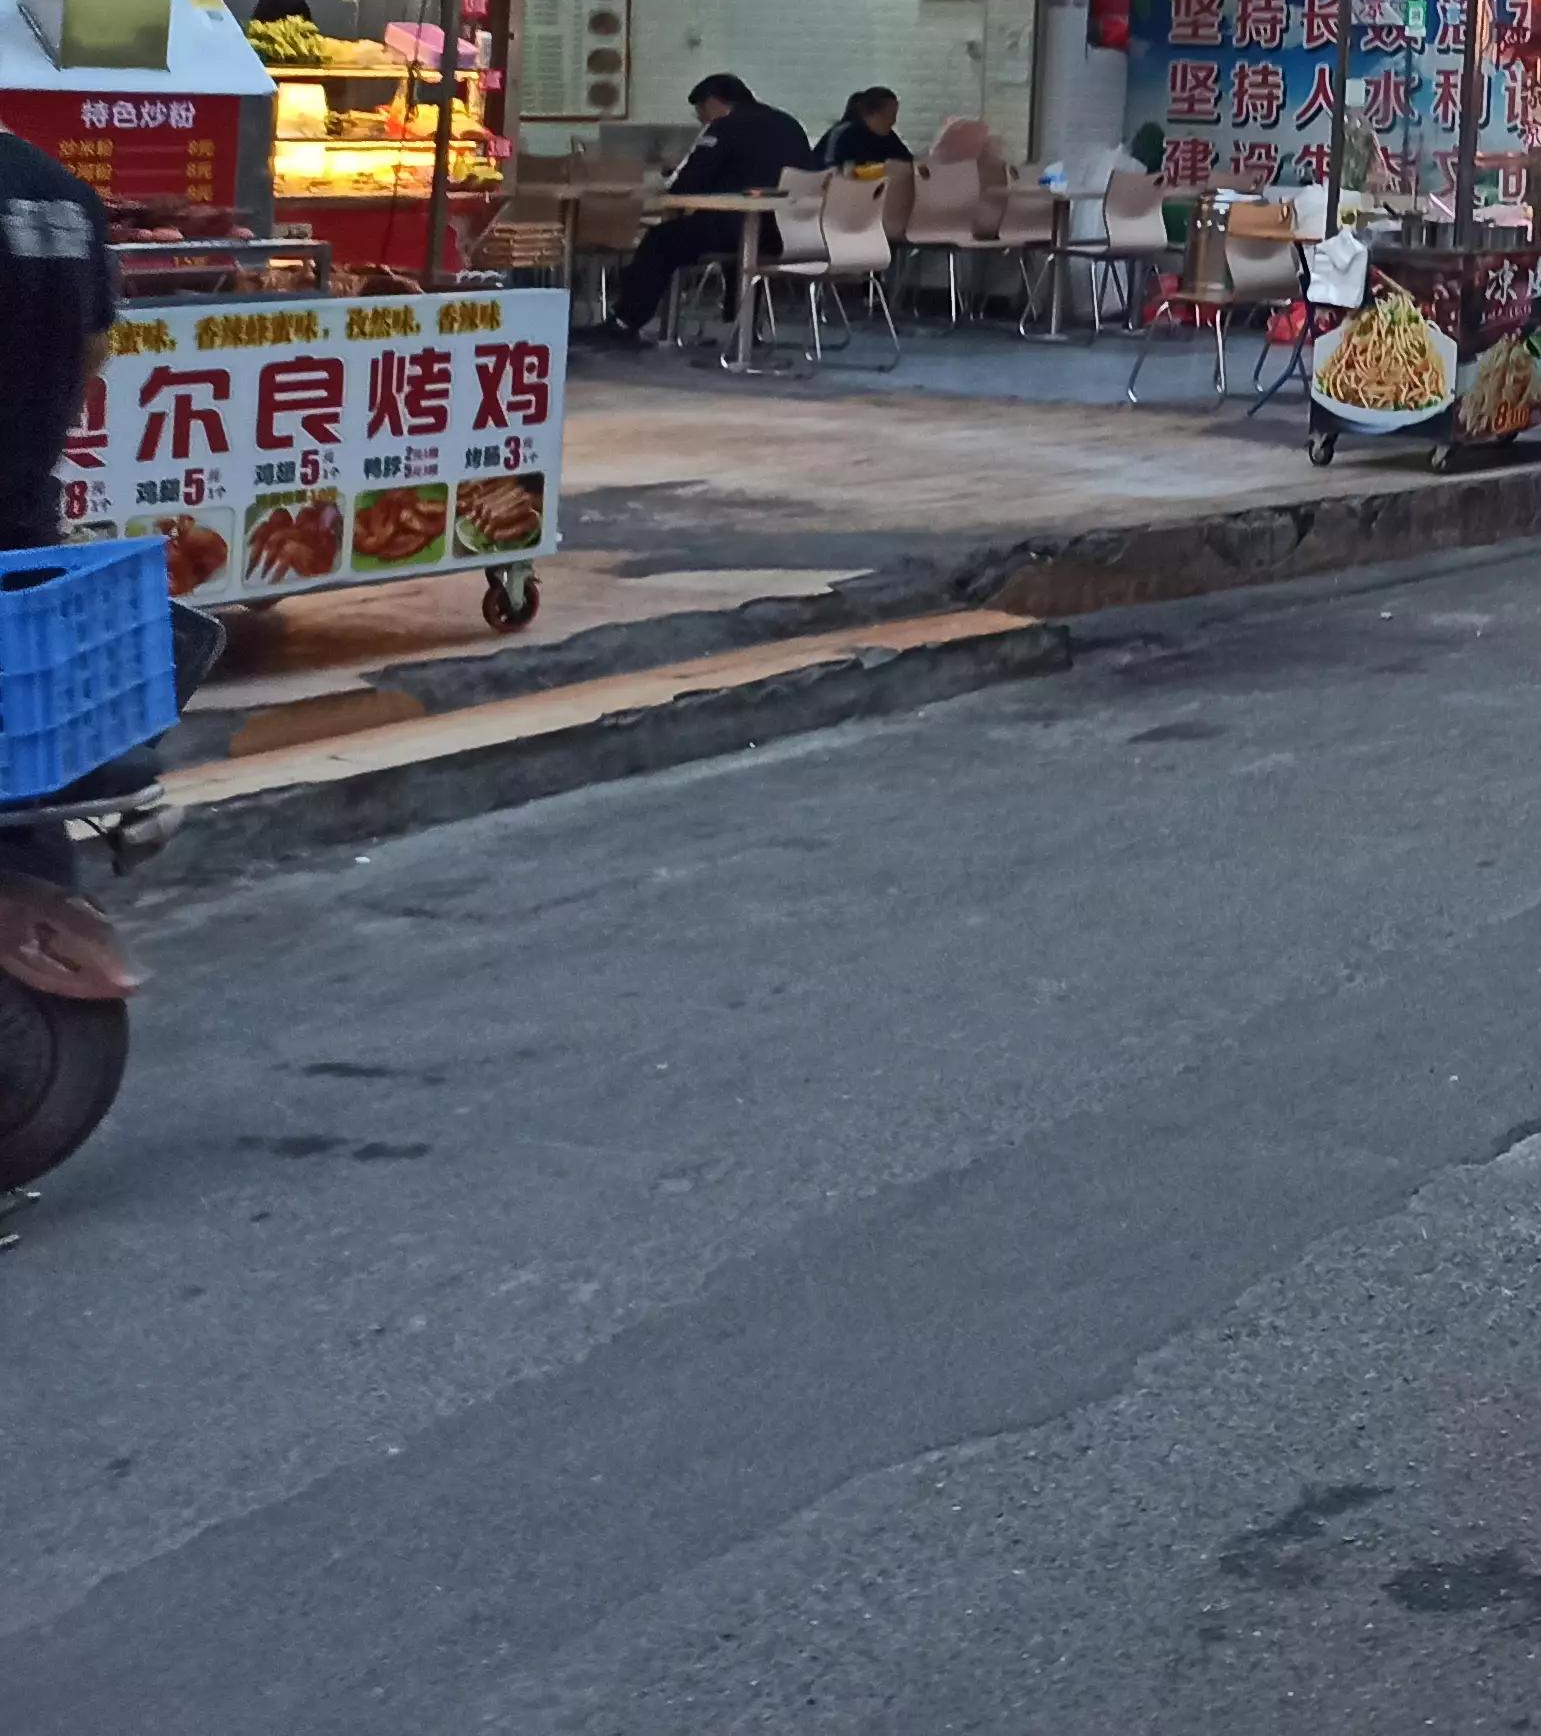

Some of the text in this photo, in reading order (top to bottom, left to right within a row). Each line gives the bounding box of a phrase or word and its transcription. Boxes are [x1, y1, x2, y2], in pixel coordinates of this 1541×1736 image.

[300, 449, 320, 486] 5
[503, 435, 521, 471] 3
[64, 480, 88, 520] 8
[183, 468, 205, 506] 5
